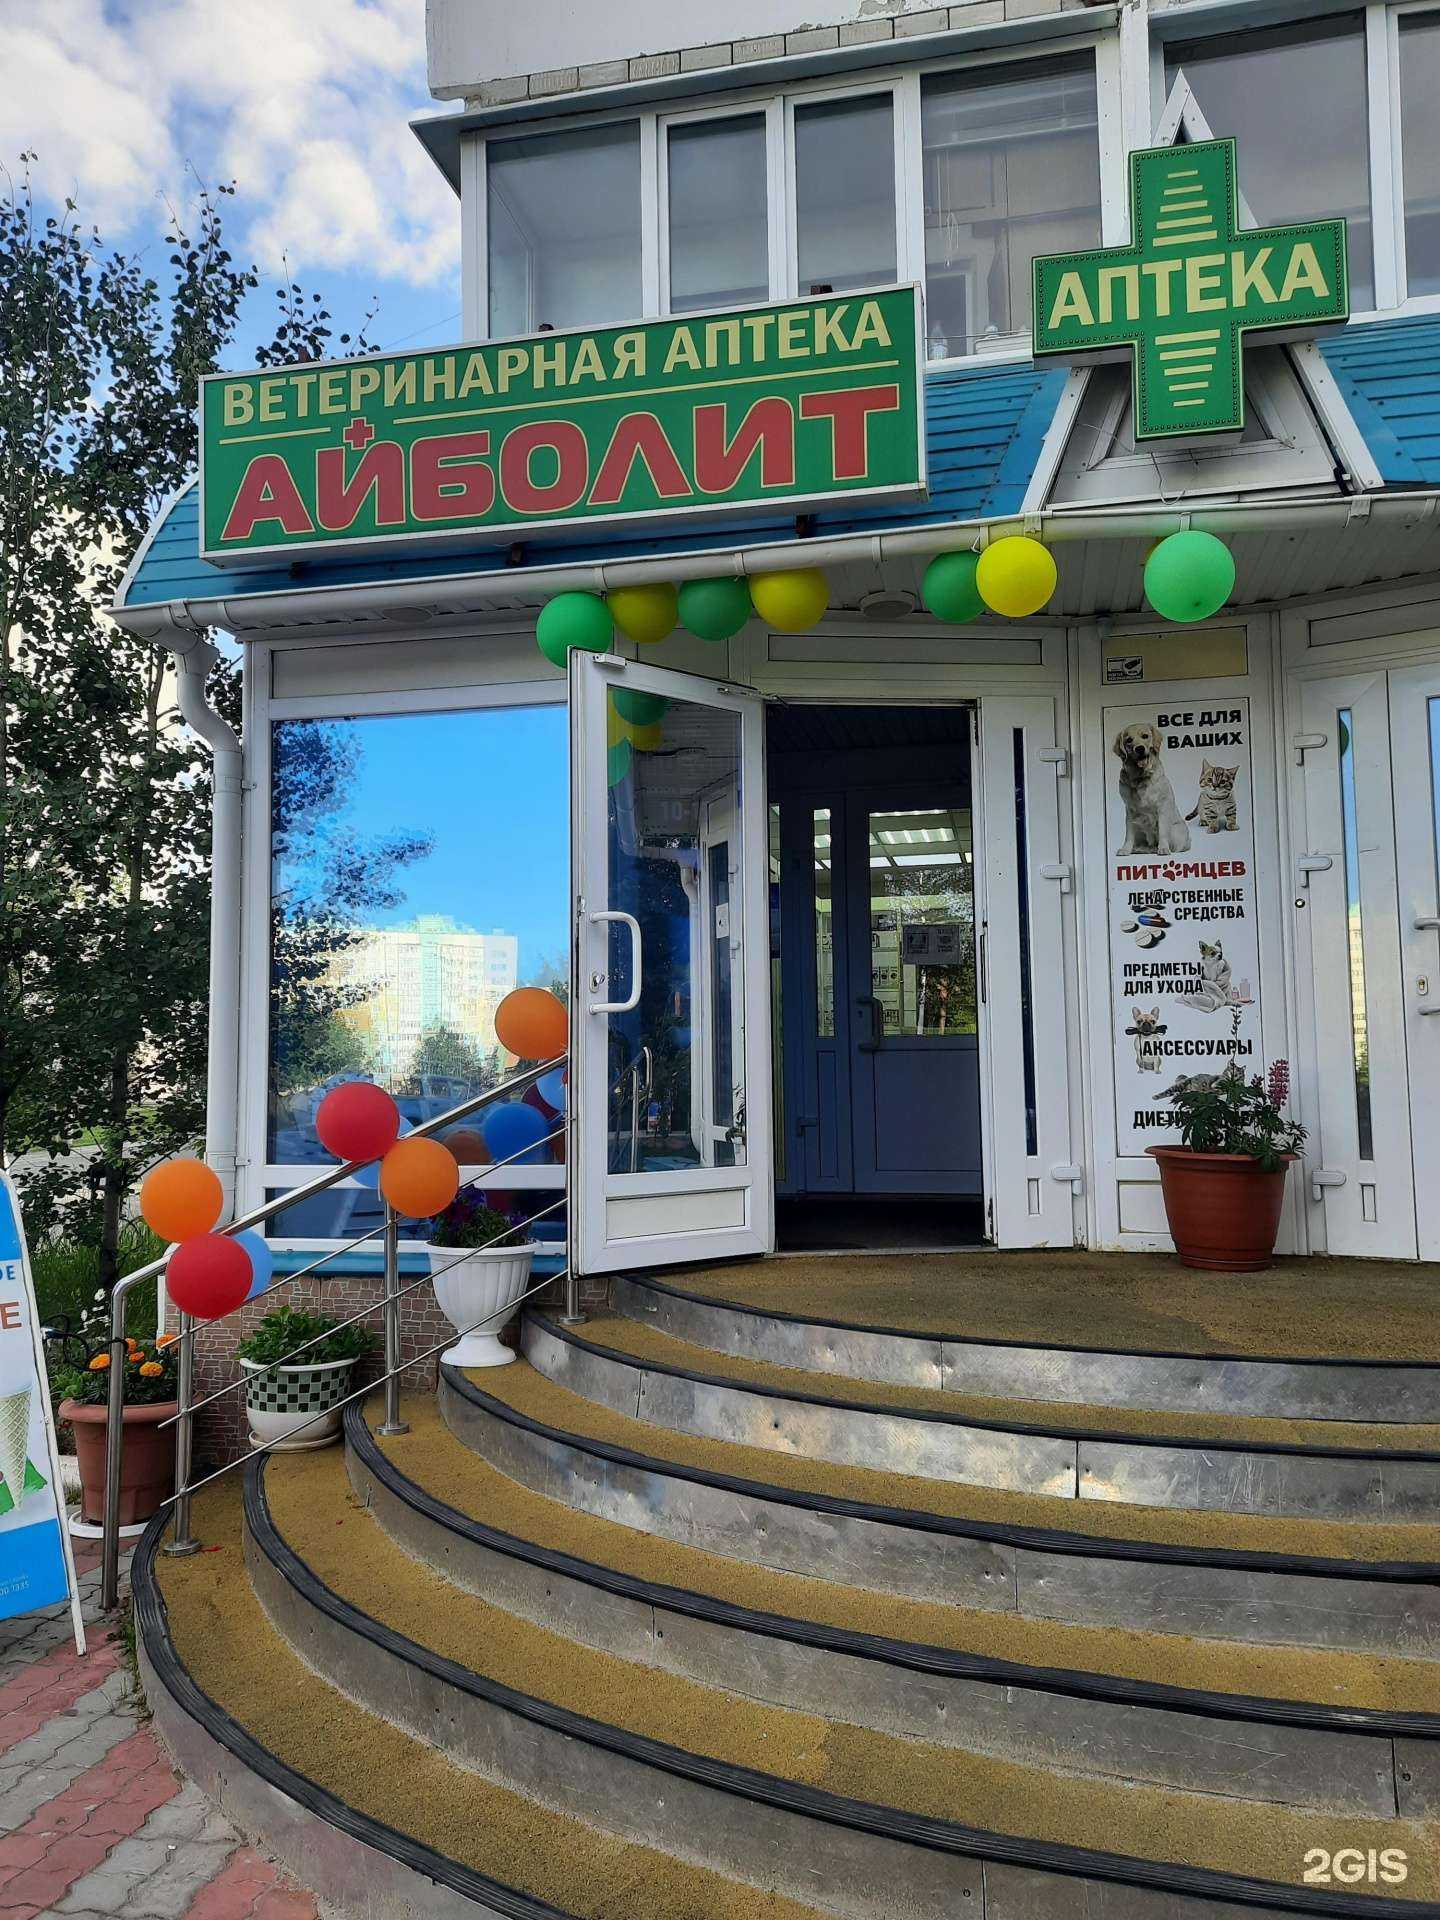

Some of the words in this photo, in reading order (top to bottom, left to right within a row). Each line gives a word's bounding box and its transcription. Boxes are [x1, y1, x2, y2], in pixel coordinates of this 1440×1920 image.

[1048, 242, 1330, 329] АПТЕКА
[223, 330, 646, 427] ВЕТЕРИНАРНАЯ
[662, 300, 892, 374] АПТЕКА
[220, 383, 900, 541] АЙБОЛИТ
[1157, 713, 1194, 728] ВСЕ
[1199, 709, 1242, 727] ДЛЯ
[1167, 731, 1243, 749] ВАШИХ
[1128, 888, 1244, 905] ЛЕКАРСТВЕННЫЕ
[1174, 905, 1244, 921] СРЕДСТВА
[1124, 962, 1204, 978] ПРЕДМЕТЫ
[1124, 981, 1153, 996] ДЛЯ
[1158, 980, 1204, 995] УХОДА
[1142, 1038, 1252, 1056] АКСЕССУАРЫ
